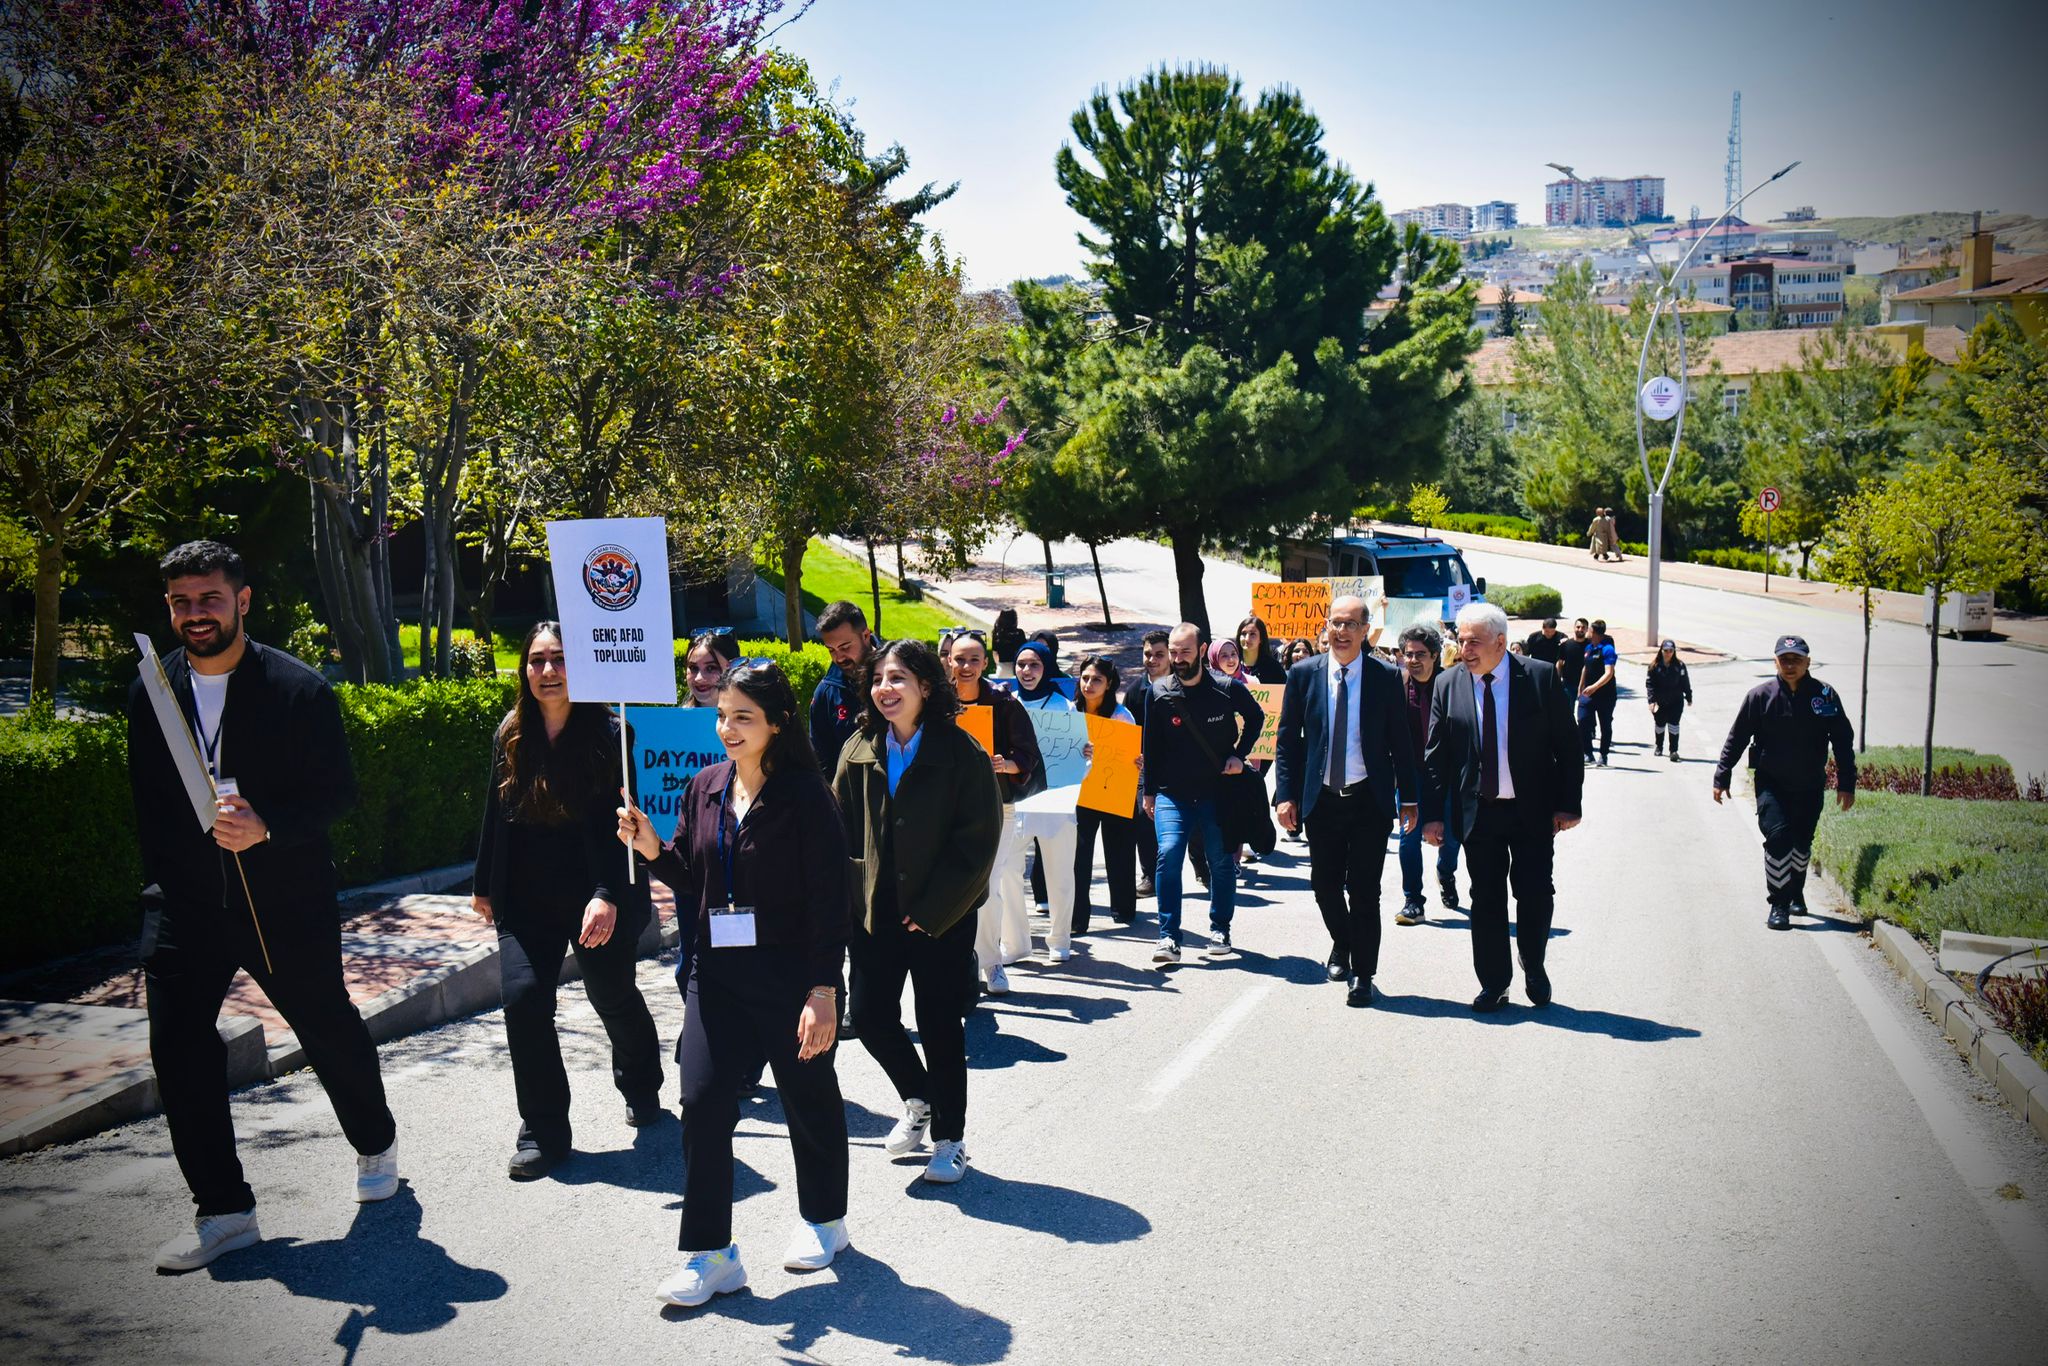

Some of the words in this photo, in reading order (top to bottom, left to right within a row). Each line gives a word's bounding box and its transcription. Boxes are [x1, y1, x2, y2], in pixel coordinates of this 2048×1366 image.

[1764, 491, 1776, 508] P
[592, 628, 617, 647] GENÇ
[619, 628, 644, 643] AFAD
[593, 646, 646, 663] TOPLULUĞU
[1102, 766, 1114, 790] ?
